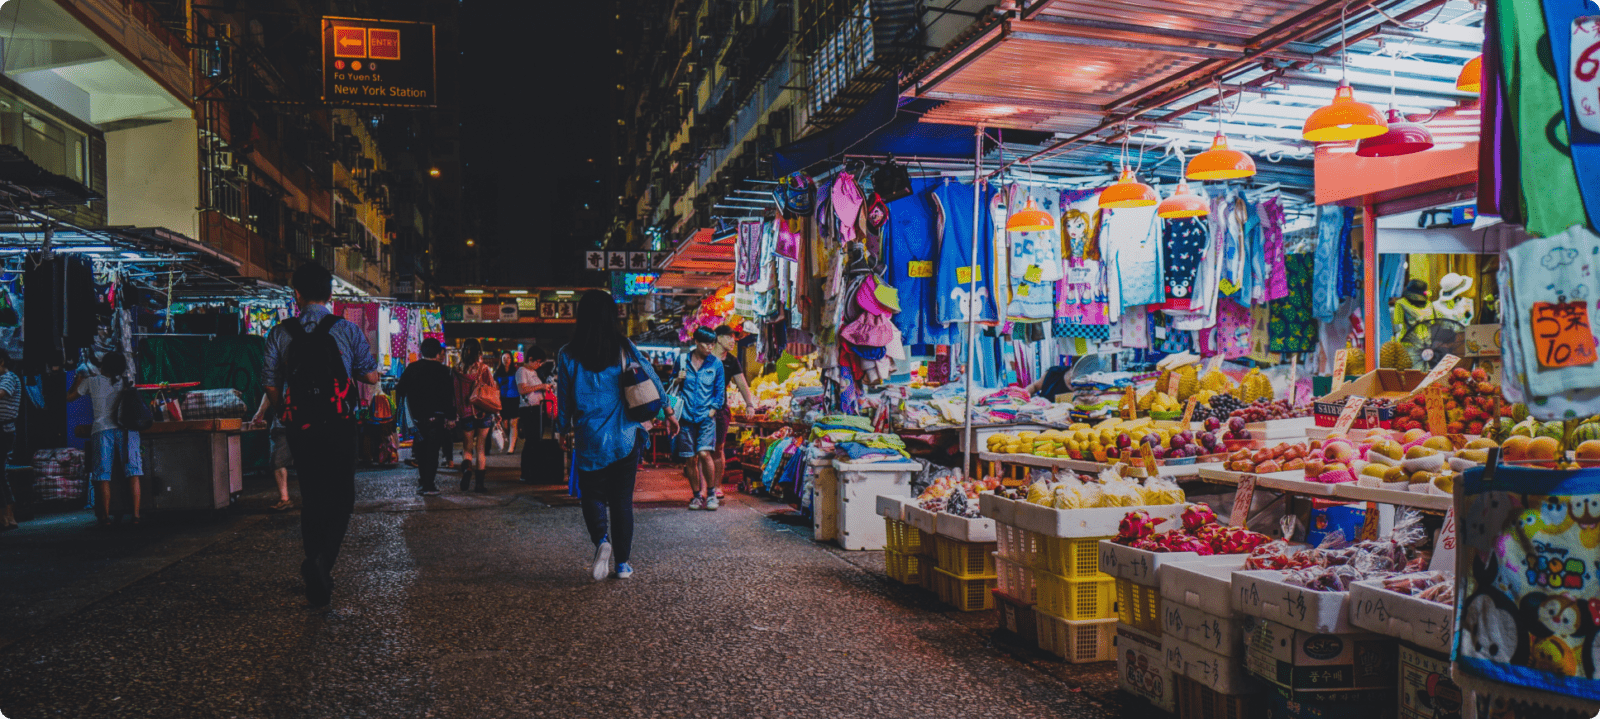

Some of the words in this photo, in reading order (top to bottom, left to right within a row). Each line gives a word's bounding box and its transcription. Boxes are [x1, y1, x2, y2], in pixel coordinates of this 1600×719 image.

[371, 38, 398, 47] ENTRY
[334, 72, 345, 80] Fa
[348, 73, 370, 81] Yuen
[372, 74, 383, 82] St.
[334, 84, 358, 95] New
[362, 85, 386, 96] York
[389, 86, 427, 98] Station
[1402, 650, 1450, 674] RANGES
[1308, 669, 1343, 683] 풍수배
